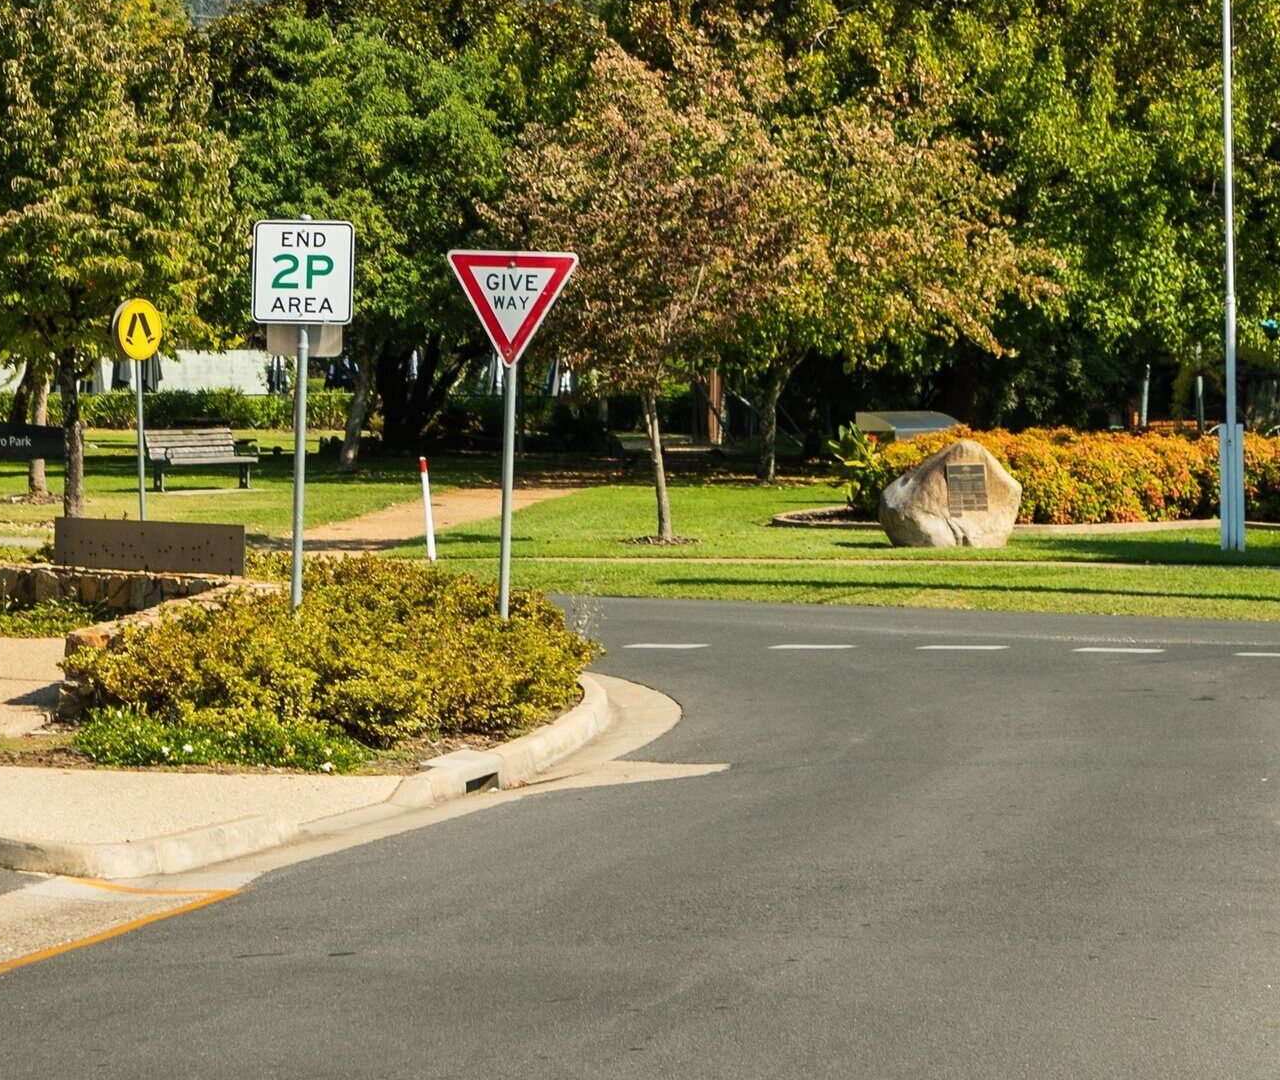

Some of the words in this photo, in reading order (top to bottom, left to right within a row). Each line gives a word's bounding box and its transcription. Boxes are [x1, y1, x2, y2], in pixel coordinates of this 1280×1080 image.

[281, 231, 327, 248] END
[271, 253, 335, 290] 2P
[486, 273, 539, 292] GIVE
[270, 296, 334, 314] AREA
[493, 295, 530, 311] WAY
[9, 435, 33, 448] Park
